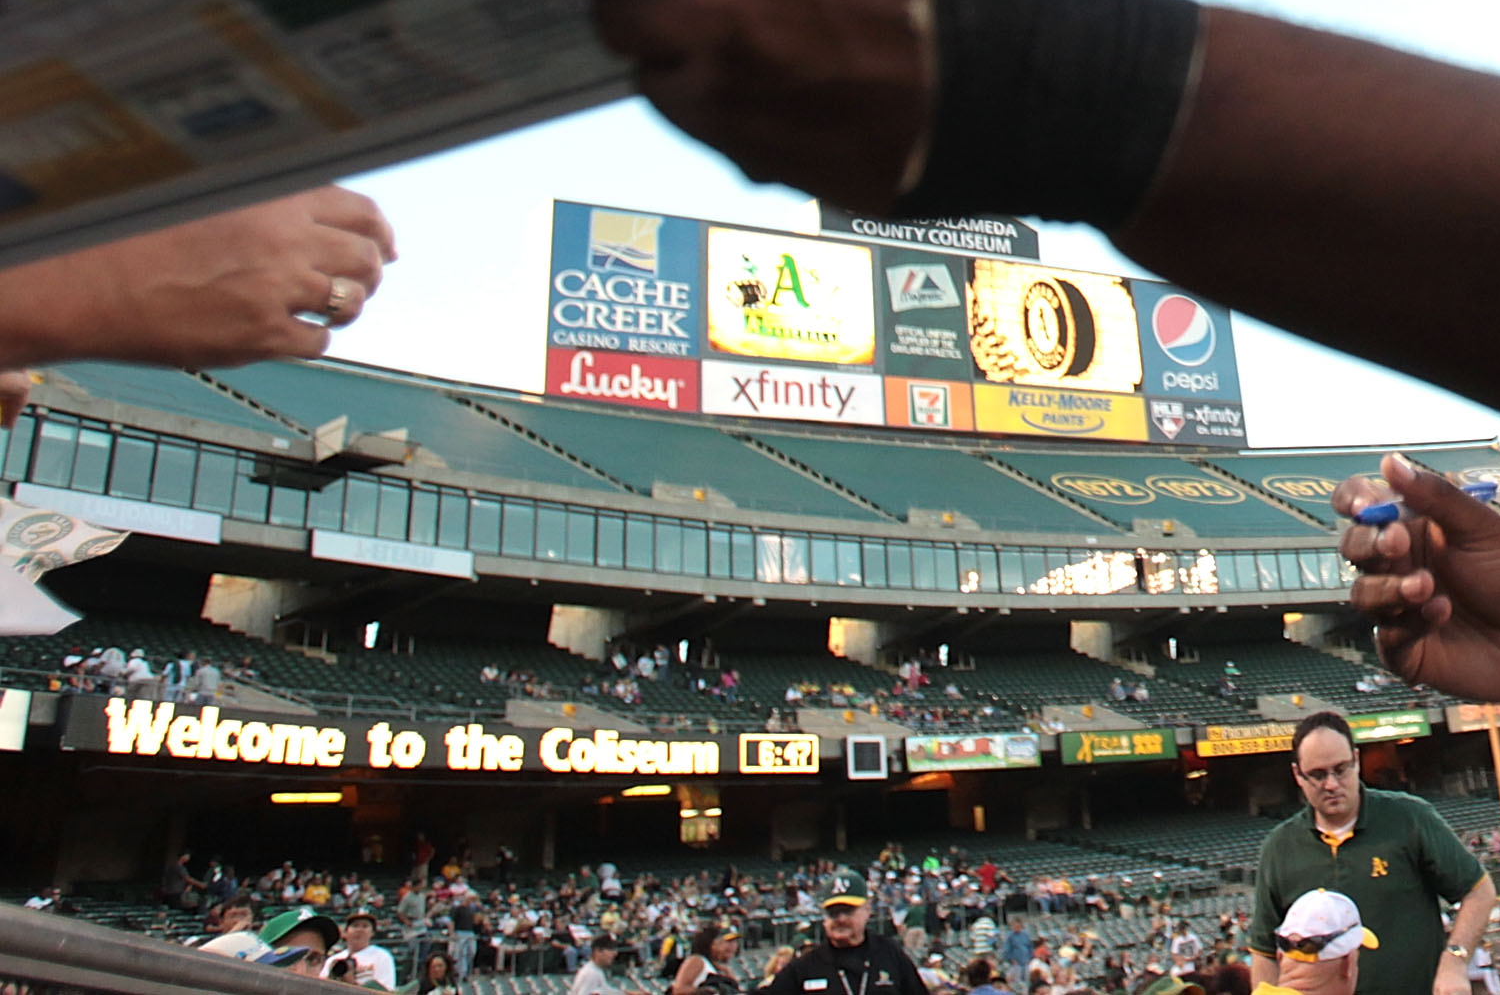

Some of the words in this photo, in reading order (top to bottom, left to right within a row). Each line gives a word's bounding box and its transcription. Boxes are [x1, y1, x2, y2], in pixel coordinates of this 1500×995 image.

[851, 217, 926, 243] COUNTY
[928, 227, 1013, 255] COLISEUM
[554, 268, 691, 310] CACHE
[553, 298, 689, 339] CREEK
[552, 328, 620, 350] CASINO
[628, 336, 692, 356] RESORT
[560, 350, 679, 410] Lucky
[732, 369, 856, 417] xfinity
[1162, 371, 1220, 393] pepsi
[1008, 389, 1113, 412] KELLY-MOORE
[1042, 413, 1086, 427] PAINTS
[1194, 405, 1242, 427] xfinity
[1063, 477, 1146, 498] 1972
[1157, 480, 1234, 498] 1973
[104, 697, 346, 767] Welcome
[367, 722, 426, 768] to
[444, 723, 525, 772] the
[539, 727, 720, 774] Coliseum
